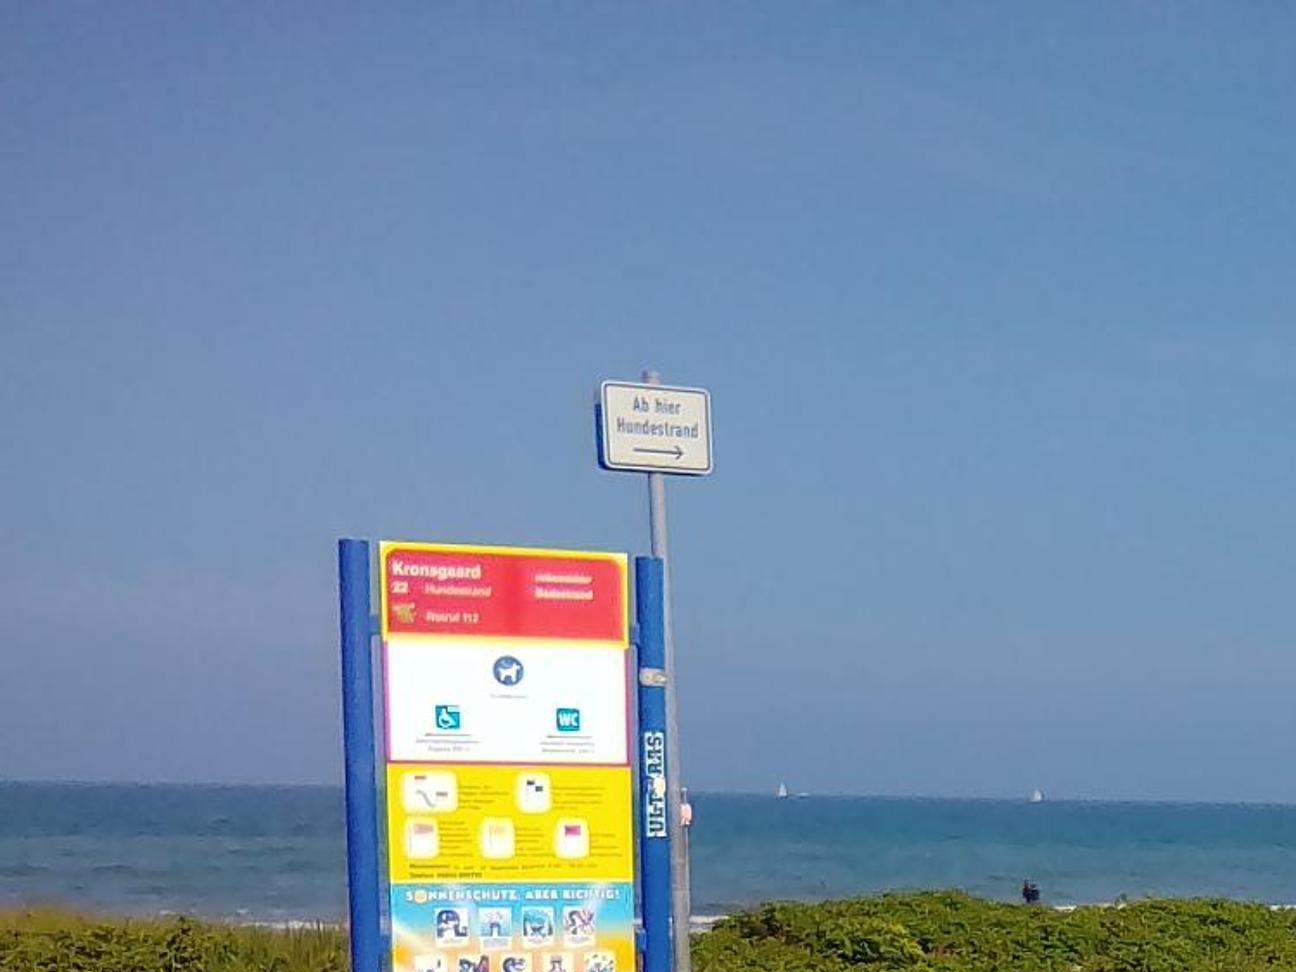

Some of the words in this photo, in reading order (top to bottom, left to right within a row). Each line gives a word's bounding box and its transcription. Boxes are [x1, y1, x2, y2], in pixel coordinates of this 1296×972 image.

[633, 396, 649, 412] Ab
[655, 398, 681, 415] hier
[616, 417, 699, 439] Hundestrand
[391, 560, 481, 580] Kronsgaard
[424, 583, 492, 598] Hundestrand
[463, 612, 479, 623] 112
[557, 712, 579, 728] WC
[525, 889, 558, 901] ABER
